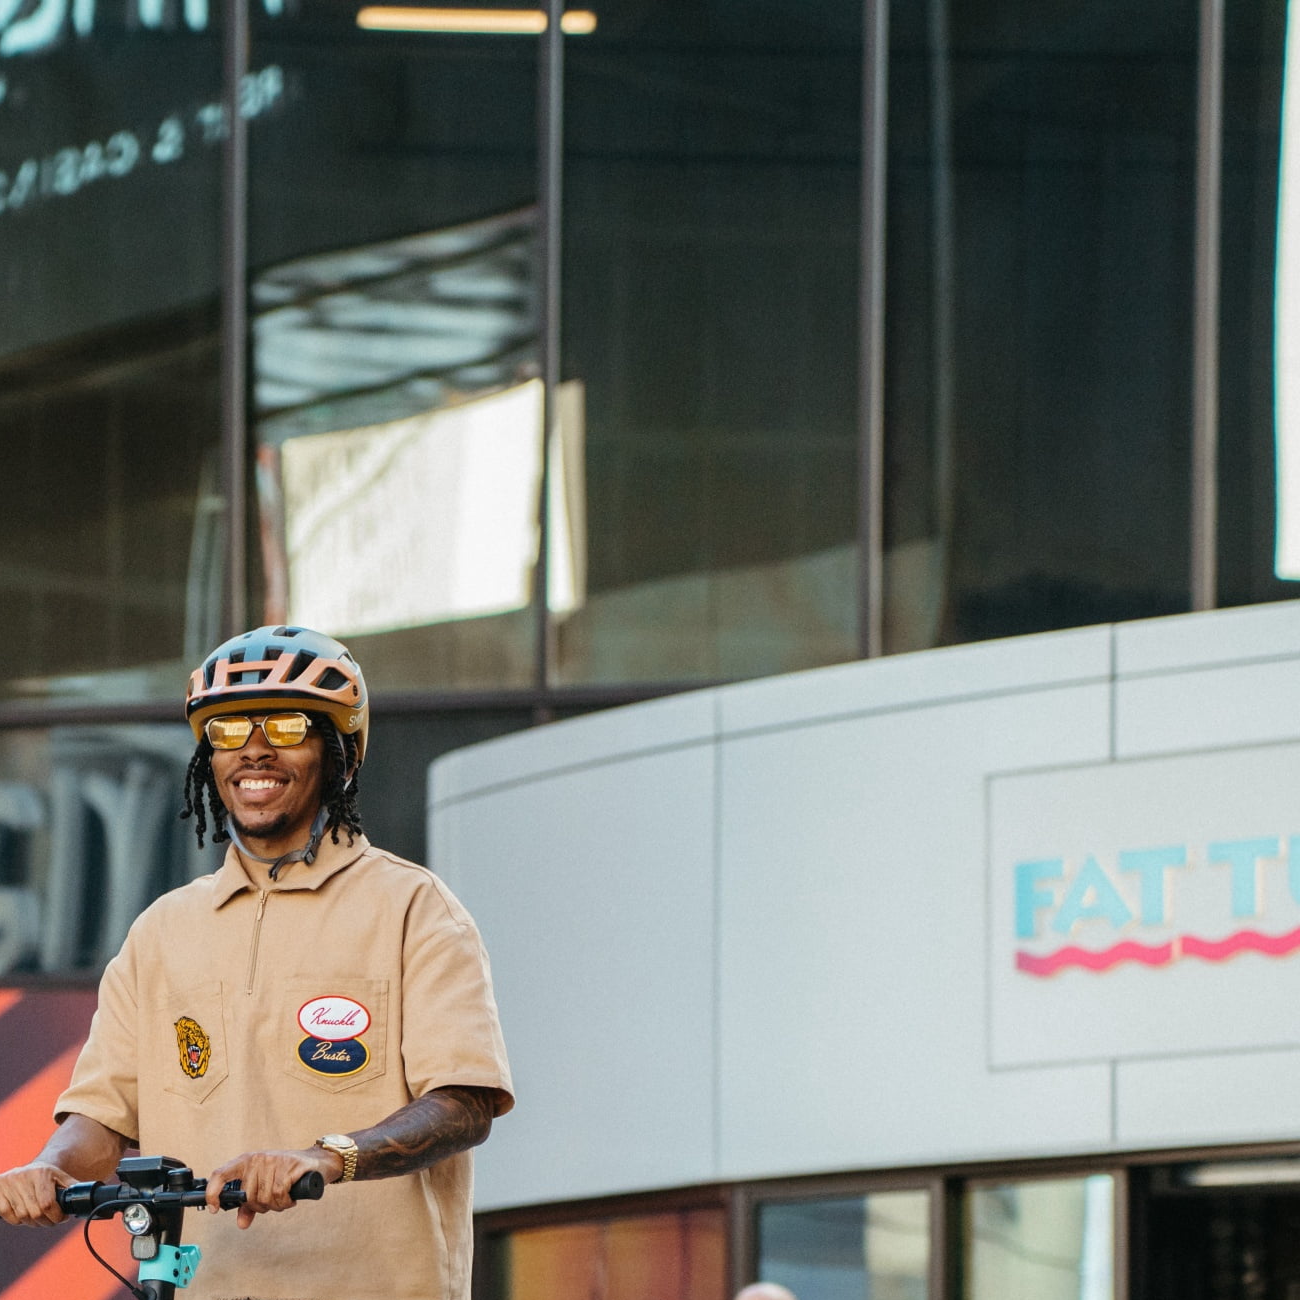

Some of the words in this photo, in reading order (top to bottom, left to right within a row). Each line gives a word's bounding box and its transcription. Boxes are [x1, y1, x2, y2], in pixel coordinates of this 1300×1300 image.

[1015, 842, 1186, 940] FAT
[310, 1007, 361, 1026] Knuckle
[311, 1041, 352, 1062] Buster
